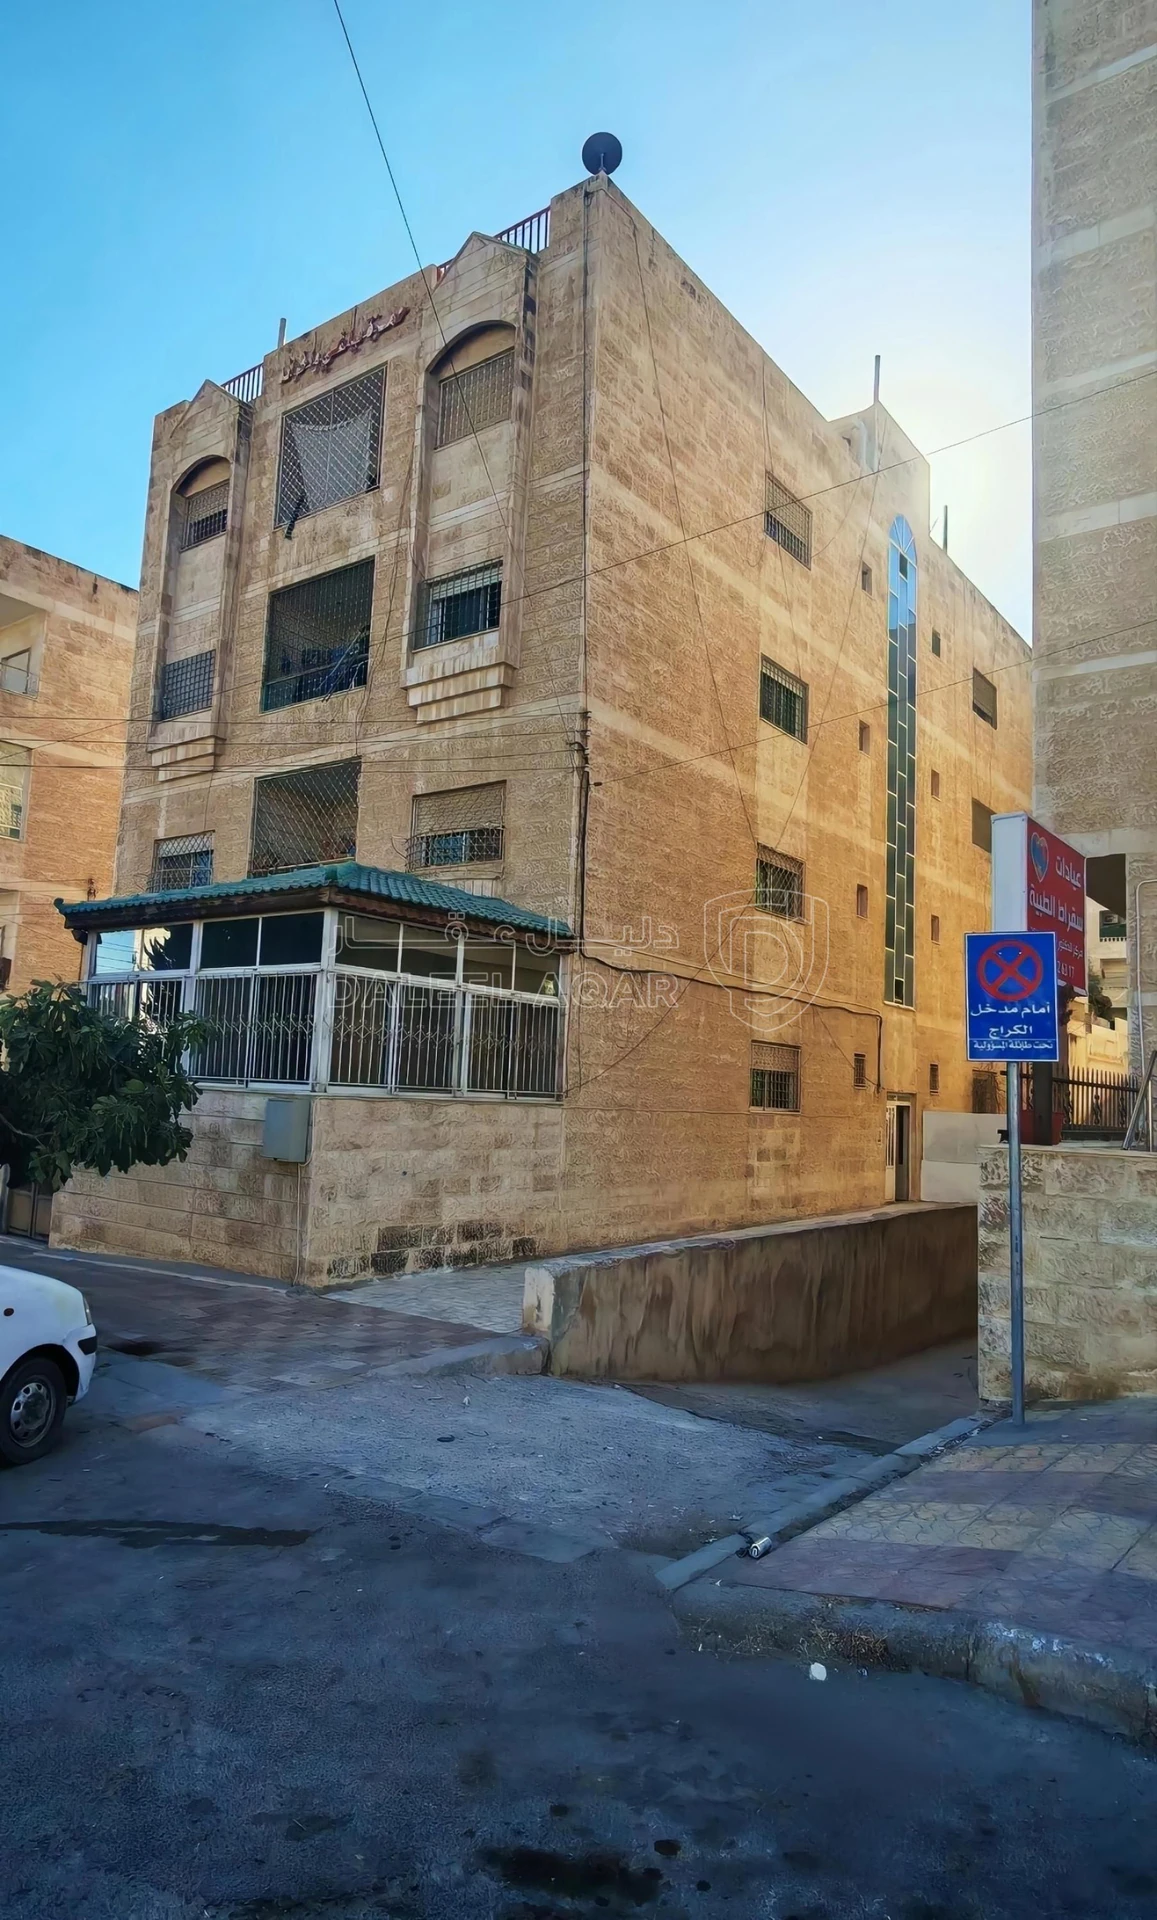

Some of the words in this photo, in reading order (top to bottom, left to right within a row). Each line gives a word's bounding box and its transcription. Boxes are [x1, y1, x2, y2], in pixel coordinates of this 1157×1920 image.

[1055, 855, 1082, 891] عيادات
[1029, 883, 1056, 918] الطبية
[1057, 899, 1084, 932] سقراط
[970, 1003, 1019, 1017] مدخل
[1021, 1001, 1050, 1018] أمام
[988, 1024, 1033, 1040] الكراج
[1033, 1040, 1054, 1049] تحت
